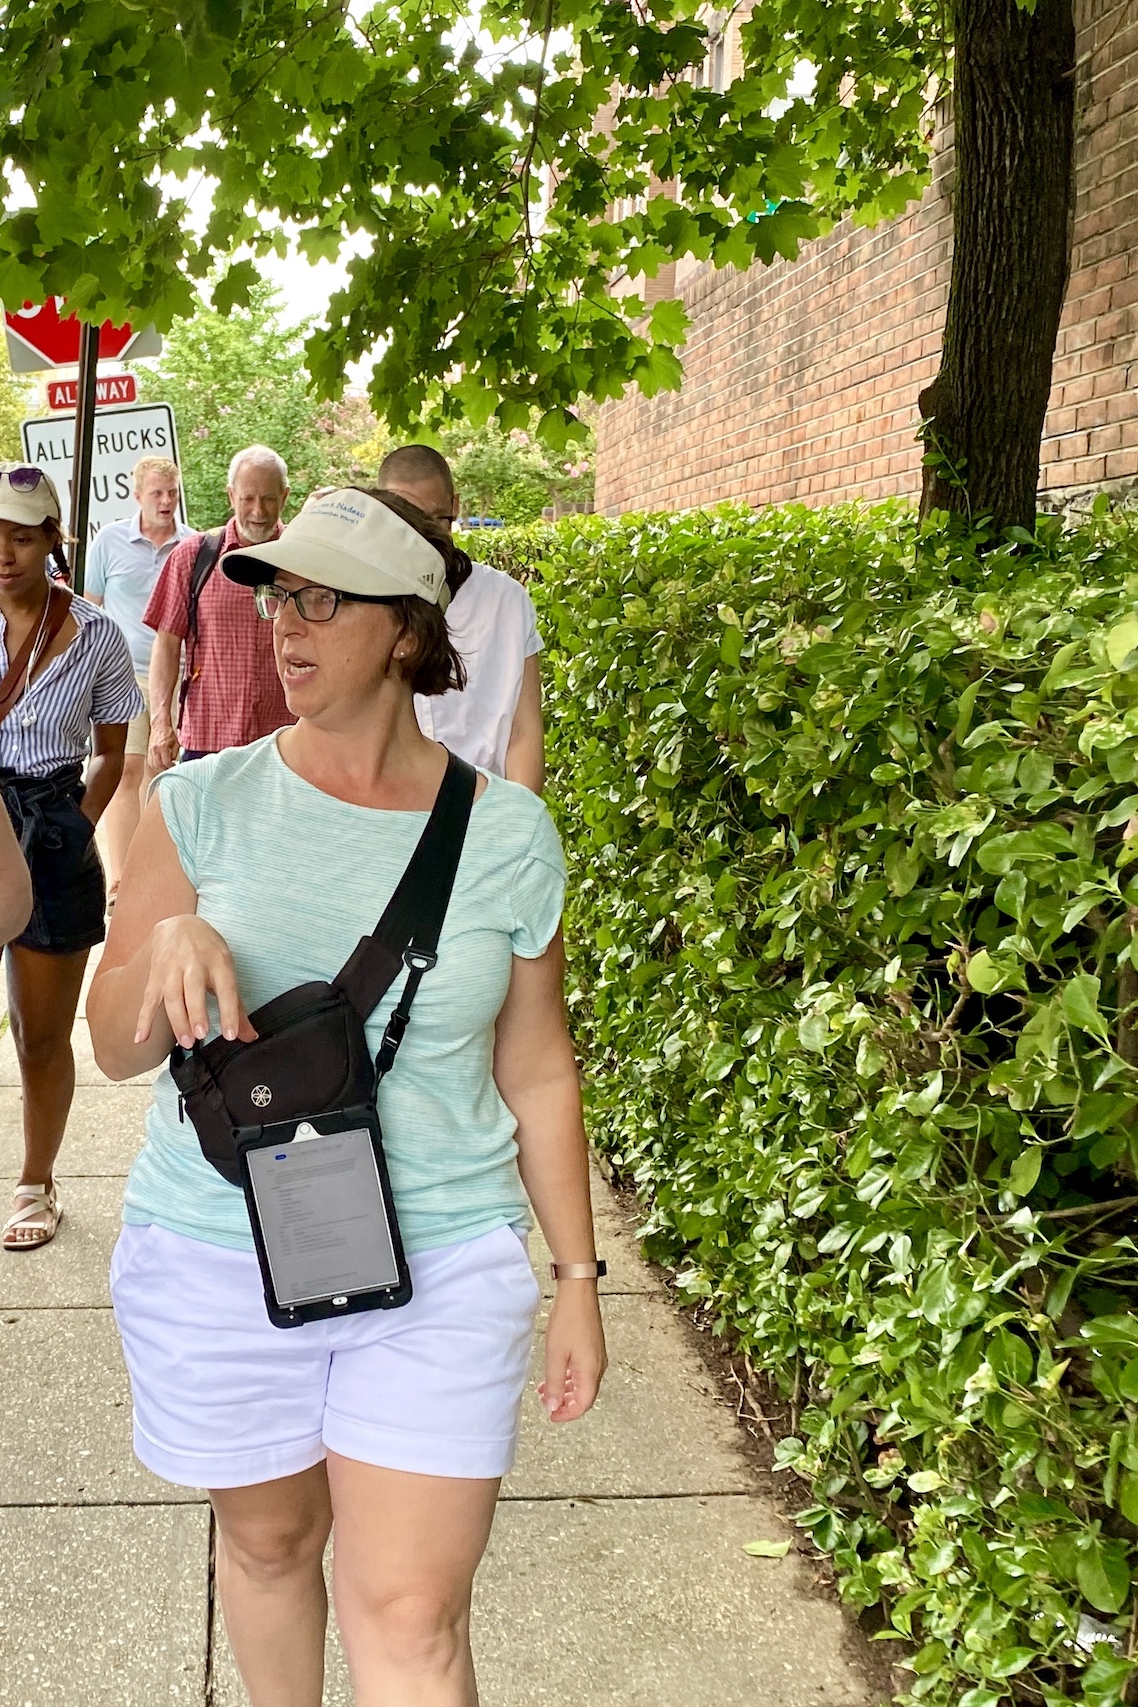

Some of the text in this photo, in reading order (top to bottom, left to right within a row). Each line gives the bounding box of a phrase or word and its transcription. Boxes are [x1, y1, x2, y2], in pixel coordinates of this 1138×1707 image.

[55, 380, 129, 405] AL WAY
[36, 426, 167, 463] ALL RUCKS
[68, 472, 133, 503] US
[336, 502, 365, 519] Nadeau
